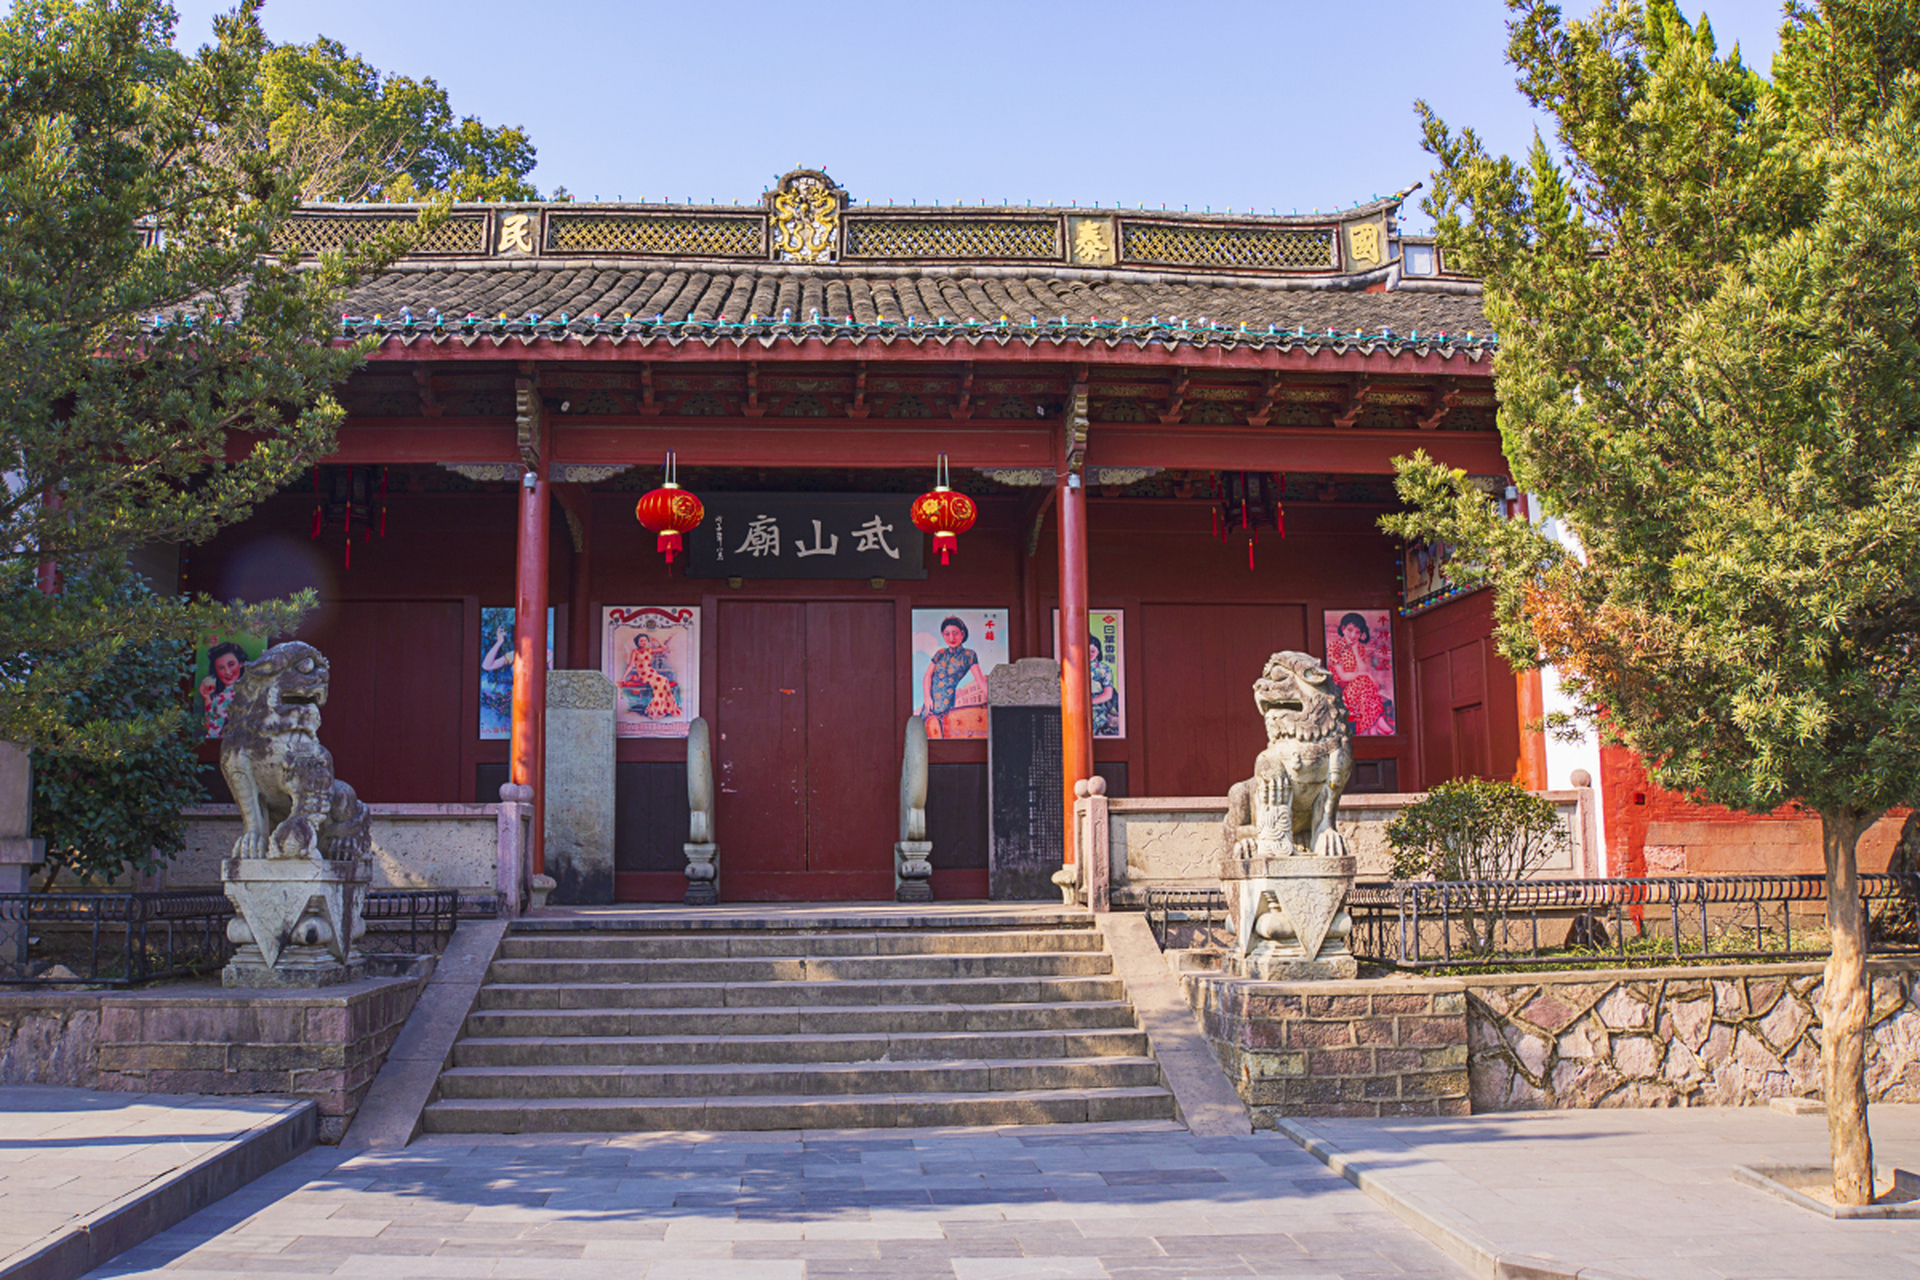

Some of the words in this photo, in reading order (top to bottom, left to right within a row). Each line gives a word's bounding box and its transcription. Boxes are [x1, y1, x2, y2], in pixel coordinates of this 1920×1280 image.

[498, 214, 533, 253] 民
[1074, 219, 1109, 261] 泰
[1350, 222, 1381, 265] 國
[733, 514, 900, 559] 武山廟
